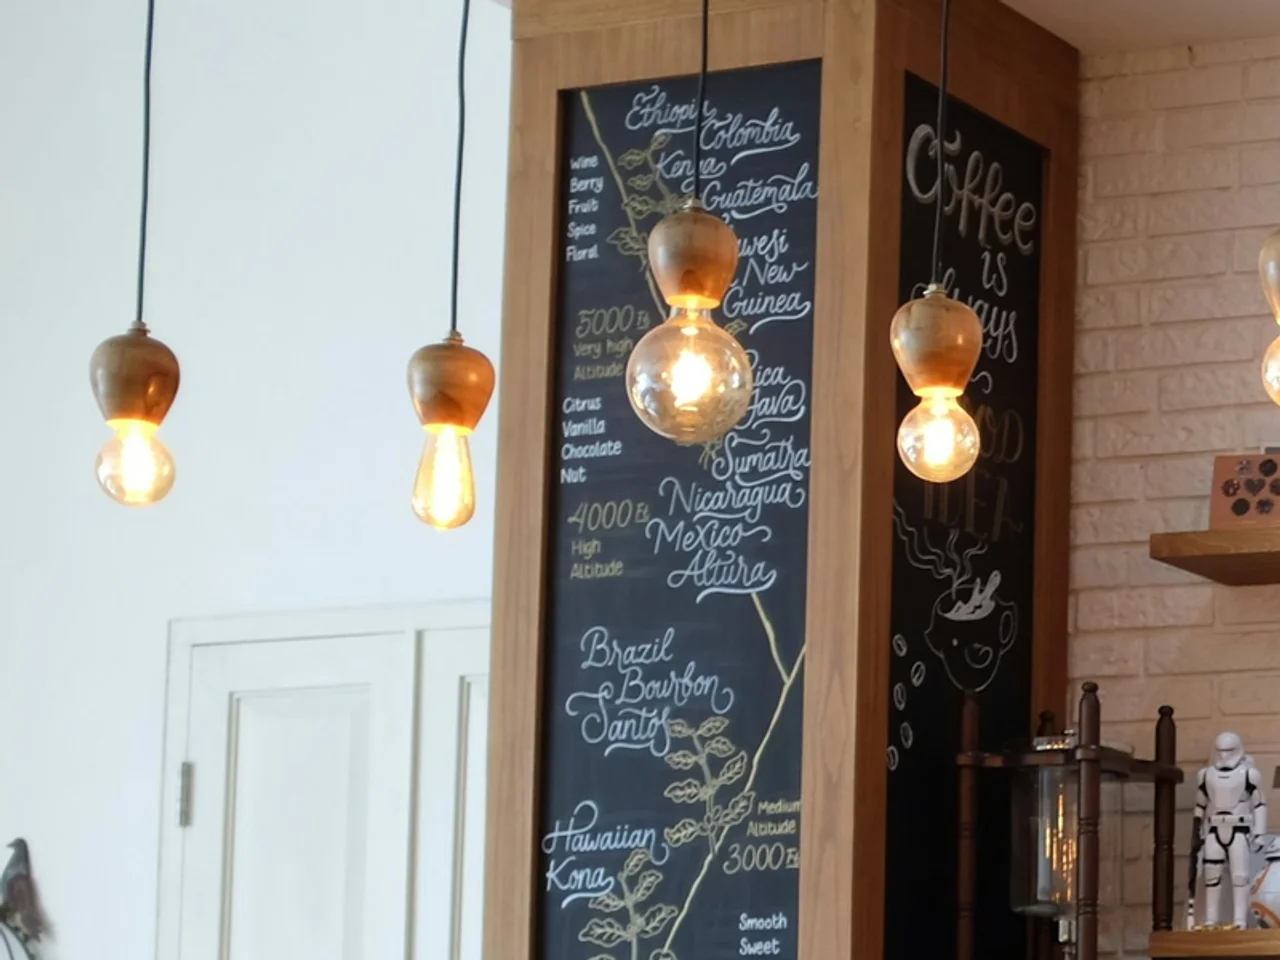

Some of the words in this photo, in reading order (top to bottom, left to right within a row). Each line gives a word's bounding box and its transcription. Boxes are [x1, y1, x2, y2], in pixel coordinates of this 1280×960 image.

[700, 107, 801, 158] Colombia
[569, 176, 604, 194] Berry
[702, 162, 820, 214] Guatemala
[905, 123, 1036, 255] Coffee
[568, 199, 599, 216] Fruit
[566, 222, 598, 240] Spice
[565, 244, 600, 263] Floral
[742, 257, 809, 287] New
[979, 247, 1008, 297] is
[574, 303, 635, 338] 5000
[723, 285, 811, 329] Guinea
[562, 396, 602, 414] Citrus
[736, 379, 805, 430] Java
[562, 418, 606, 438] Vanilla
[561, 439, 623, 460] Chocolate
[712, 429, 811, 486] Sumatra
[560, 467, 587, 484] Nut
[567, 499, 633, 534] 4000
[659, 476, 806, 523] Nicaragua
[570, 538, 602, 559] High
[645, 518, 772, 554] Mexico
[570, 560, 624, 580] Altitude
[667, 550, 777, 599] Altura
[580, 626, 676, 672] Brazil
[615, 661, 735, 714] Bourbon
[565, 682, 670, 757] Santos
[757, 799, 802, 815] Medium
[542, 800, 670, 865] Hawaiian
[746, 819, 797, 837] Altitude
[723, 842, 785, 875] 3000
[546, 856, 615, 902] Kona
[739, 912, 788, 931] Smooth
[739, 938, 781, 956] Sweet
